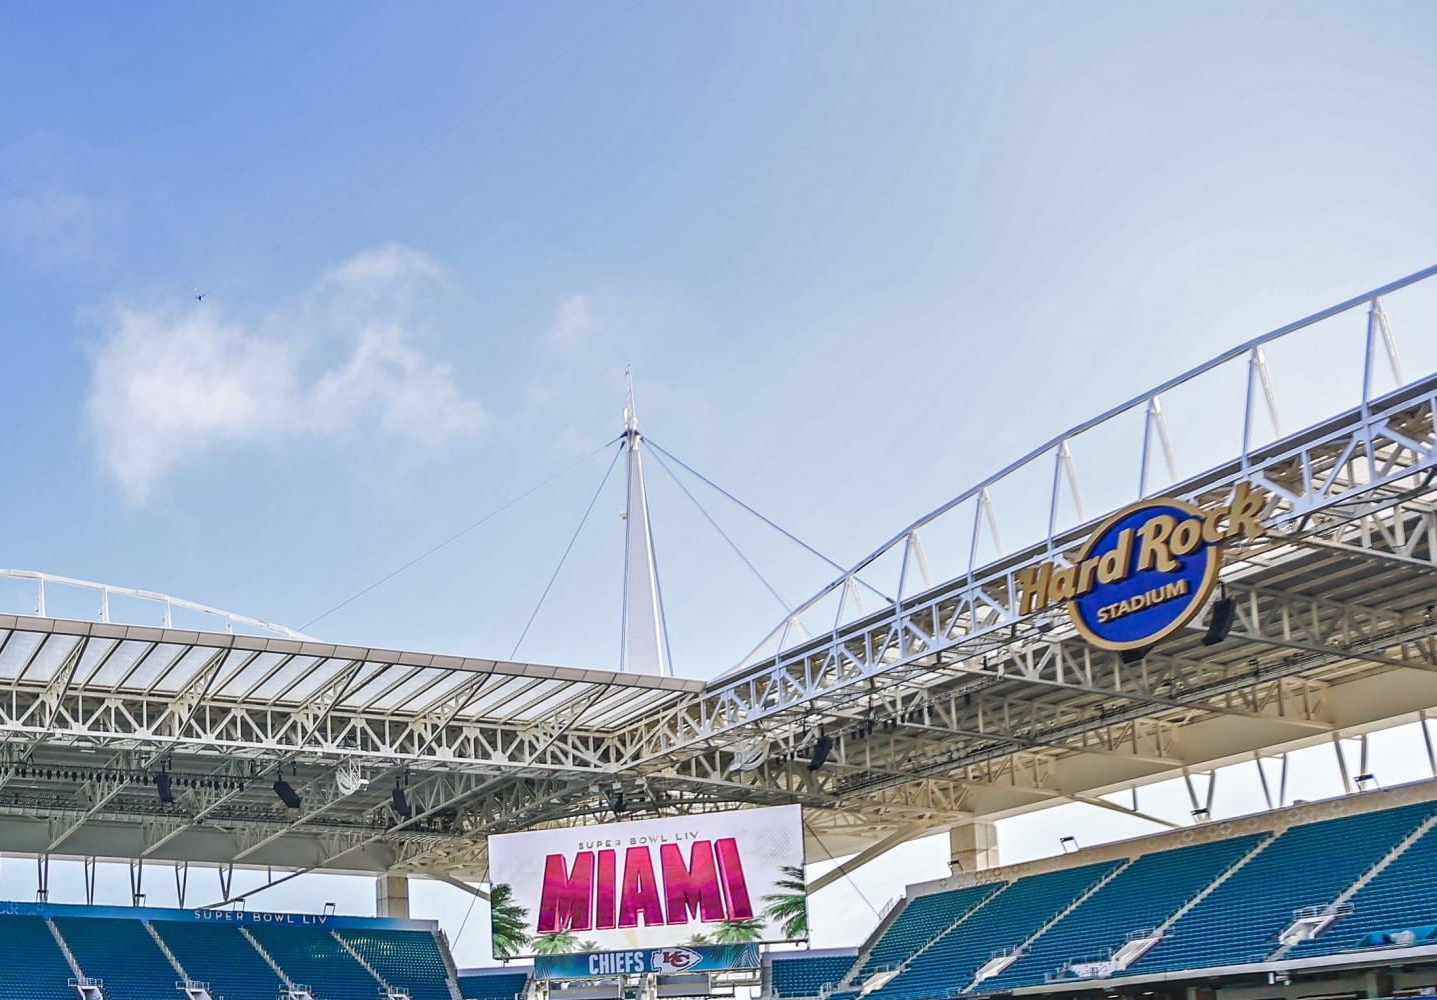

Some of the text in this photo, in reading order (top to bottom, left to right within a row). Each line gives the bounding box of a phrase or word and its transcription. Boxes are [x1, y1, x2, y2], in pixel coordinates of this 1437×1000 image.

[1015, 480, 1267, 616] Hard Rock
[1096, 579, 1189, 624] STADIUM
[578, 831, 699, 850] SUPER BOWL LIV
[536, 837, 754, 934] MIAMI
[194, 910, 328, 924] SUPER BOWL LIV
[588, 951, 644, 975] CHIEFS
